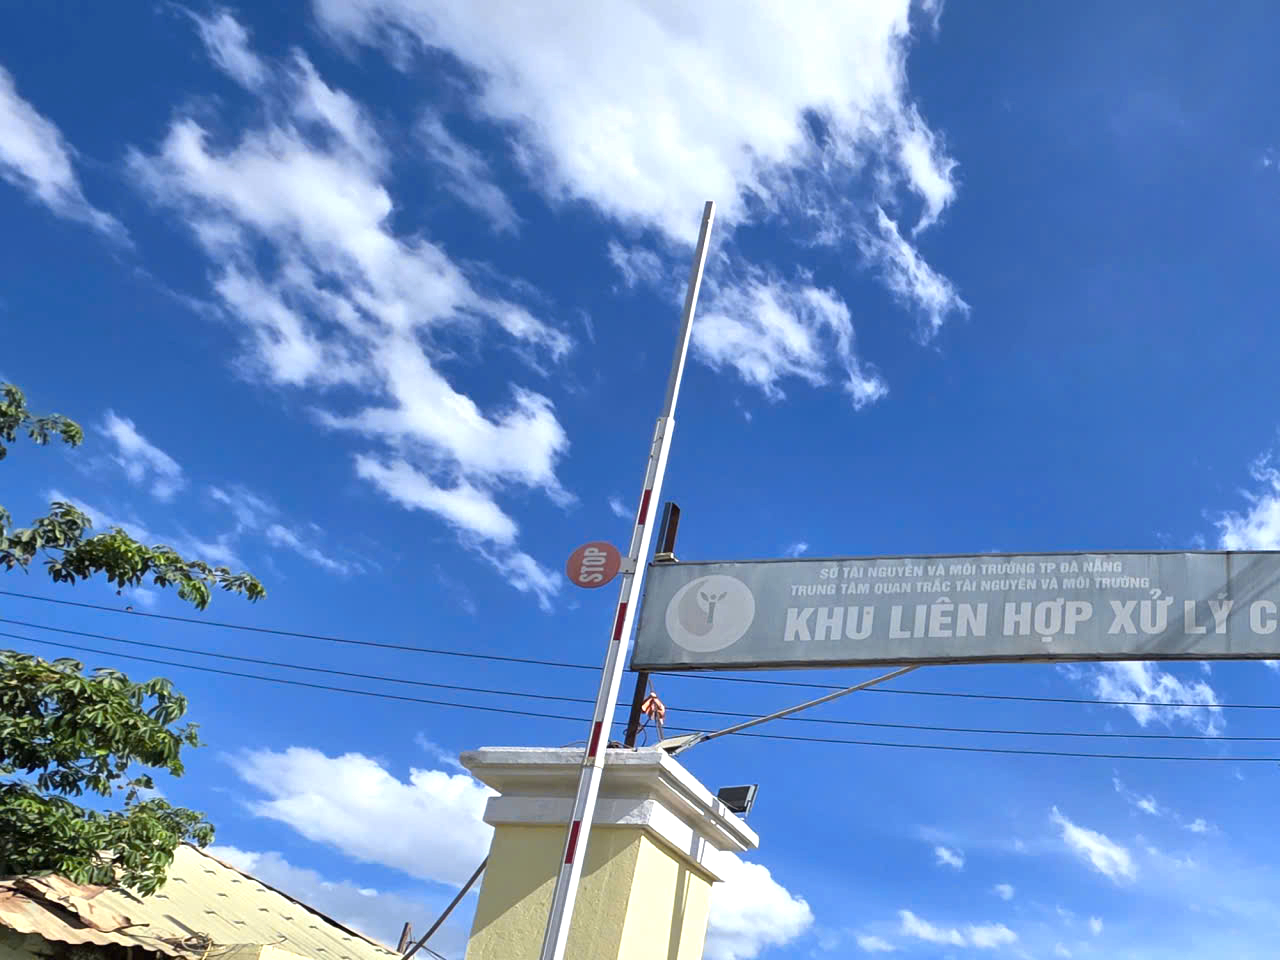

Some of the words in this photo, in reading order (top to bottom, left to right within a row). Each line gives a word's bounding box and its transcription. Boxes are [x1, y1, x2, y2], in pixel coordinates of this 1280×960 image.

[579, 547, 607, 582] STOP
[843, 566, 863, 579] TÀI
[868, 563, 923, 577] NGUYÊN
[927, 563, 945, 577] VÀ
[950, 563, 977, 576] MÔI
[1040, 561, 1056, 574] TP
[791, 583, 836, 597] TRUNG
[840, 582, 870, 595] TÂM
[874, 582, 912, 594] QUAN
[955, 579, 977, 592] TÀI
[980, 578, 1037, 591] NGUYÊN
[1041, 576, 1058, 590] VÀ
[1063, 575, 1089, 589] MÔI
[784, 606, 874, 641] KHU
[889, 596, 988, 639] LIÊN
[1003, 597, 1093, 643] HỢP
[1107, 588, 1174, 635] XỬ
[1184, 592, 1234, 634] LÝ
